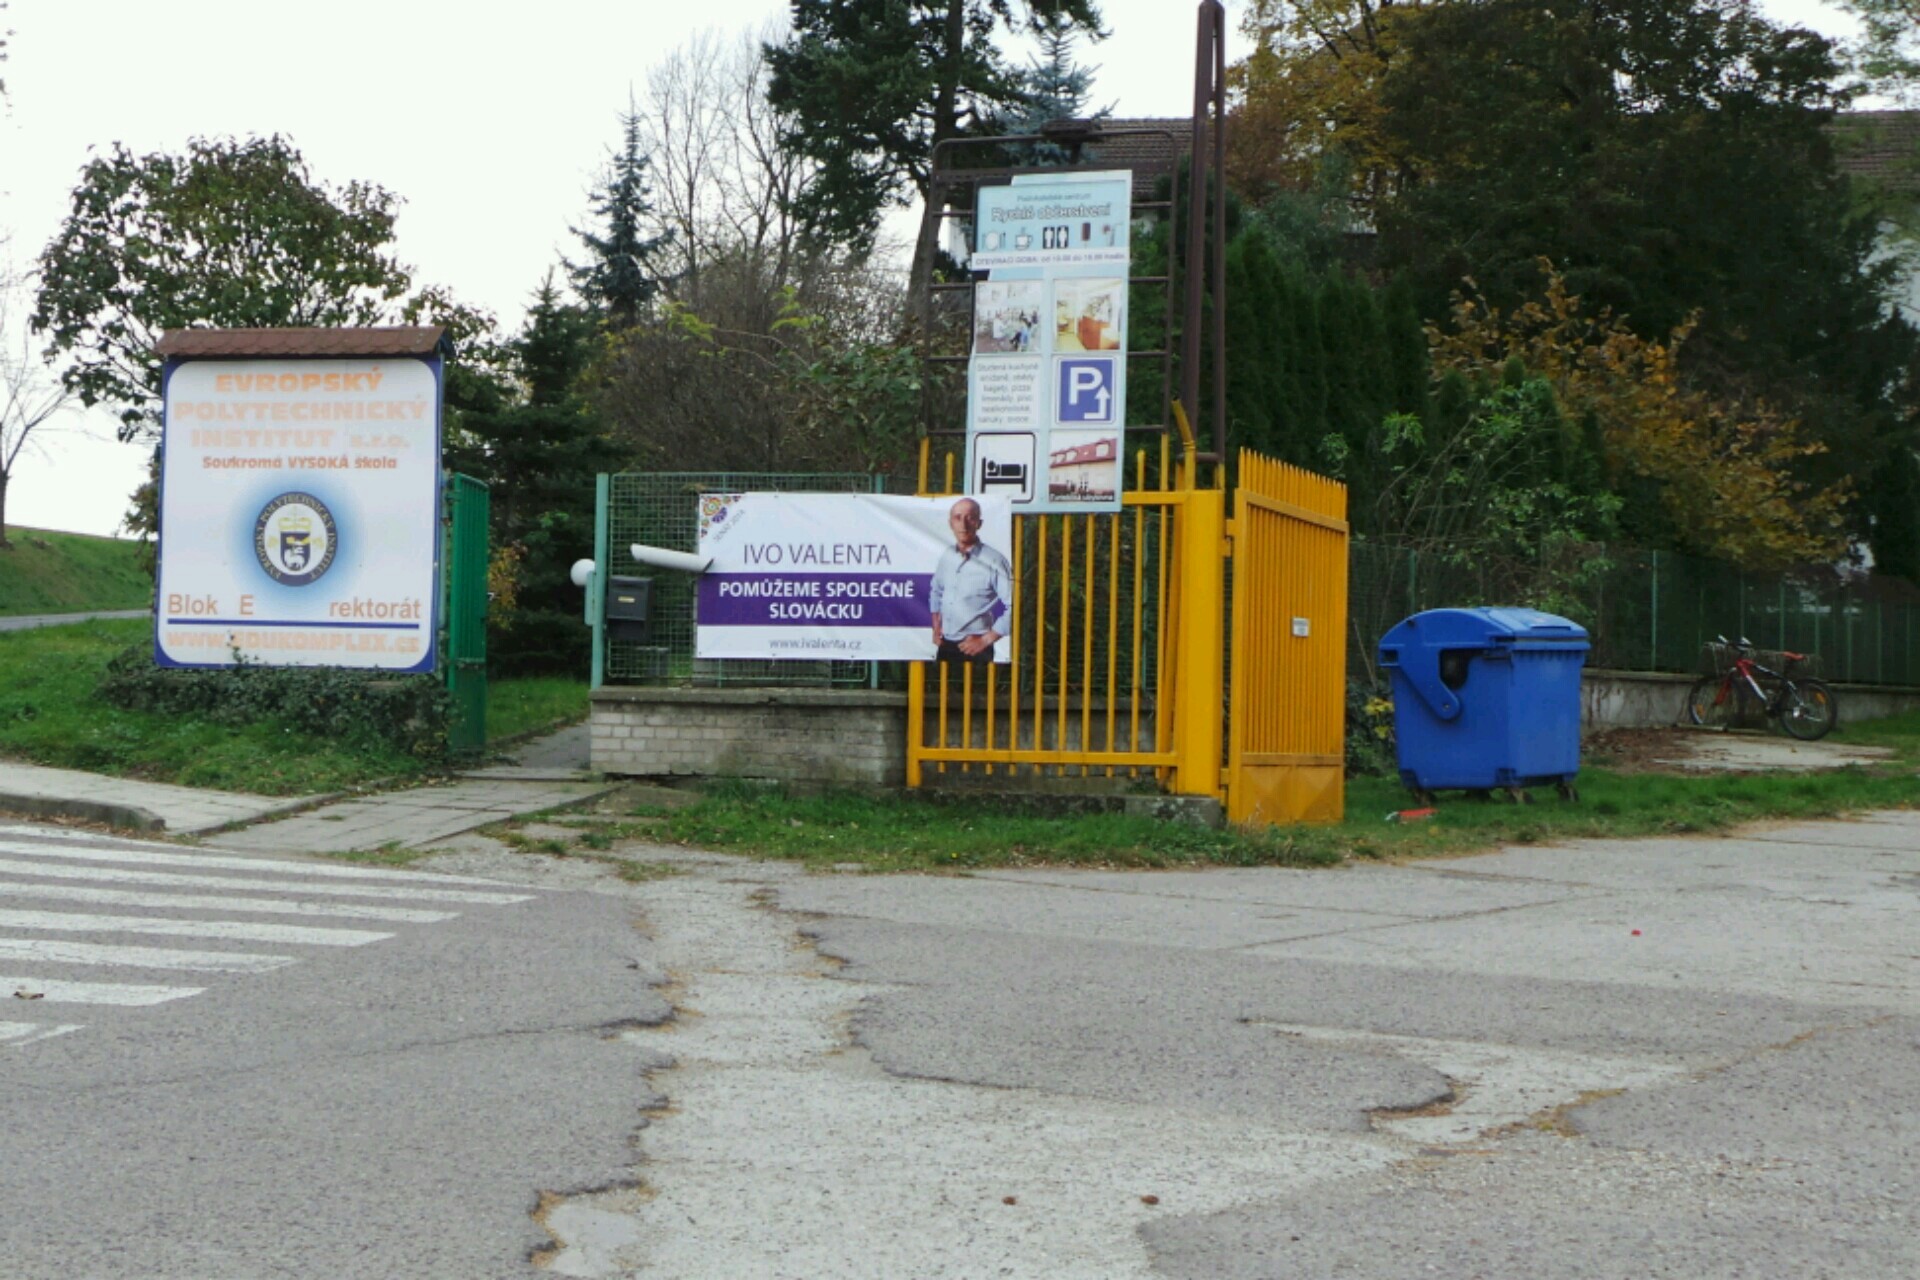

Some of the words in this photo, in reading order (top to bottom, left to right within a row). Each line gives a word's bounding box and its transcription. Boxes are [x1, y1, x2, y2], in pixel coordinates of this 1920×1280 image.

[215, 366, 384, 392] EVROPSKÝ
[1068, 367, 1104, 405] P
[172, 395, 428, 421] POLYTECHNICKÝ
[191, 429, 335, 448] INSTITUT
[350, 433, 412, 448] s.r.o.
[288, 454, 349, 469] VYSOKÁ
[354, 455, 397, 469] škola
[743, 544, 783, 564] IVO
[789, 544, 891, 565] VALENTA
[719, 579, 820, 598] POMŮŽEME
[826, 580, 915, 598] SPOLEČNĚ
[168, 594, 218, 615] Blok
[239, 594, 254, 616] E
[329, 597, 422, 619] rektorát
[769, 600, 863, 619] SLOVÁCKU
[768, 637, 862, 650] www.ivalenta.cz
